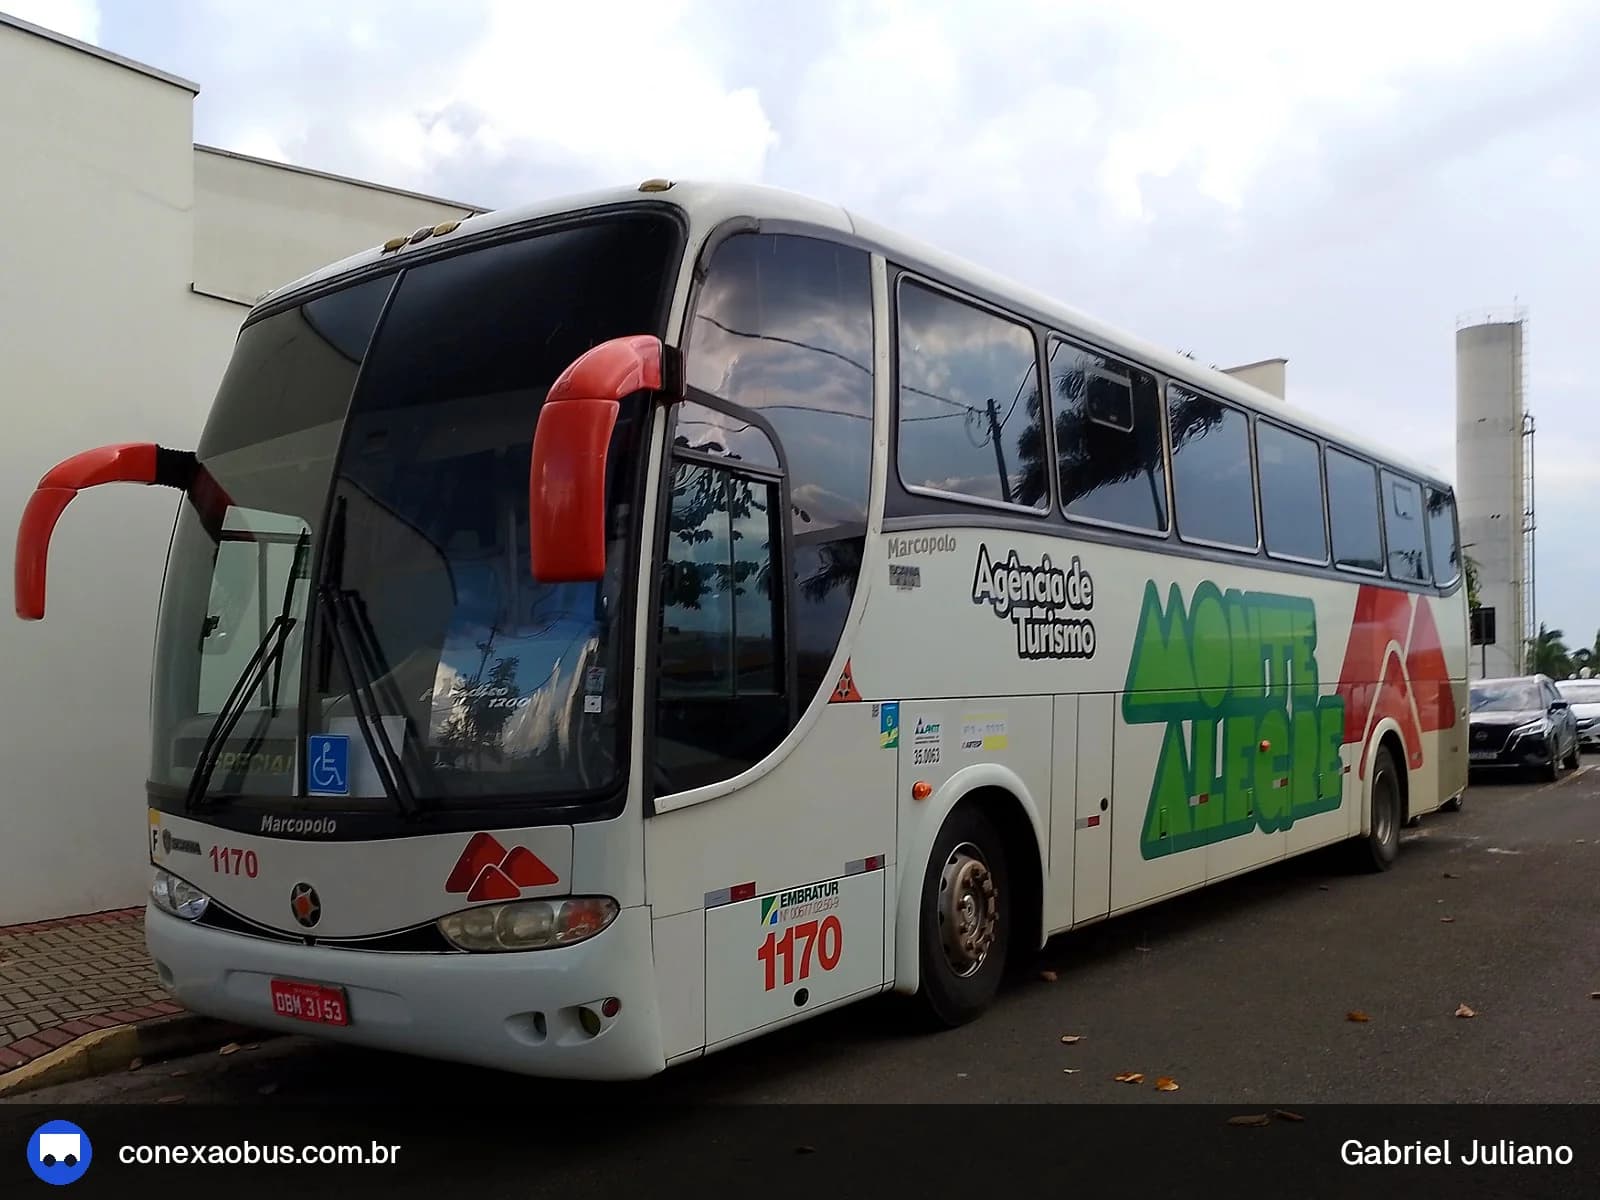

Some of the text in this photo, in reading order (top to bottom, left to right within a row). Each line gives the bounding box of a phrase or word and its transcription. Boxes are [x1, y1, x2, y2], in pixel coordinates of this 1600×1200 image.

[887, 534, 957, 559] Marcopolo
[972, 541, 1094, 619] Agência de
[1011, 606, 1097, 661] Turismo
[1122, 579, 1319, 722] MONTE
[1140, 695, 1345, 861] ALEGRE
[260, 815, 337, 834] Marcopolo
[209, 845, 259, 879] 1170
[780, 880, 839, 909] EMBRATUR
[757, 915, 843, 992] 1170
[305, 997, 343, 1021] 3153
